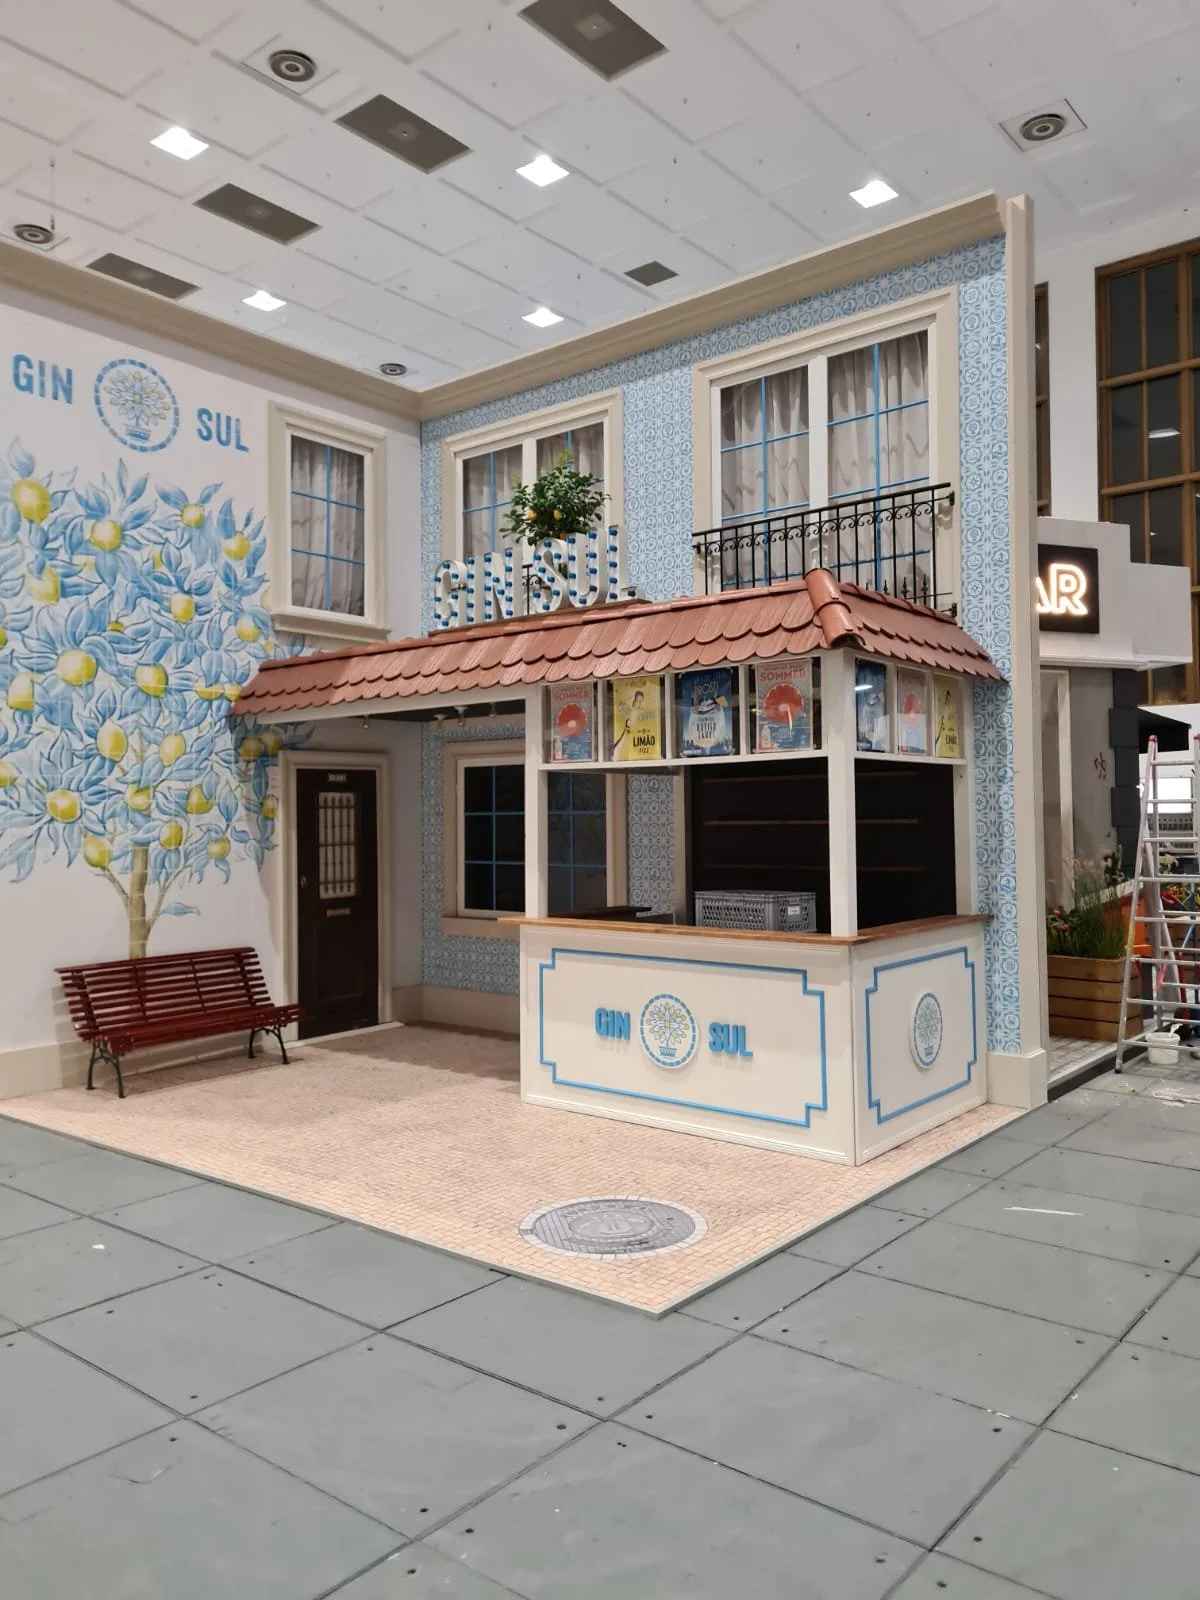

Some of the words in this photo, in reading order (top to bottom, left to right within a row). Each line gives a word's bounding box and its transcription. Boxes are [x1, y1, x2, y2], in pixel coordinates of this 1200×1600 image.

[12, 353, 74, 405] GIN
[196, 407, 250, 453] SUL
[434, 548, 514, 628] GIN
[532, 525, 641, 614] SUL
[633, 734, 655, 747] LIMÃO
[594, 1007, 631, 1041] GIN
[708, 1021, 754, 1058] SUL
